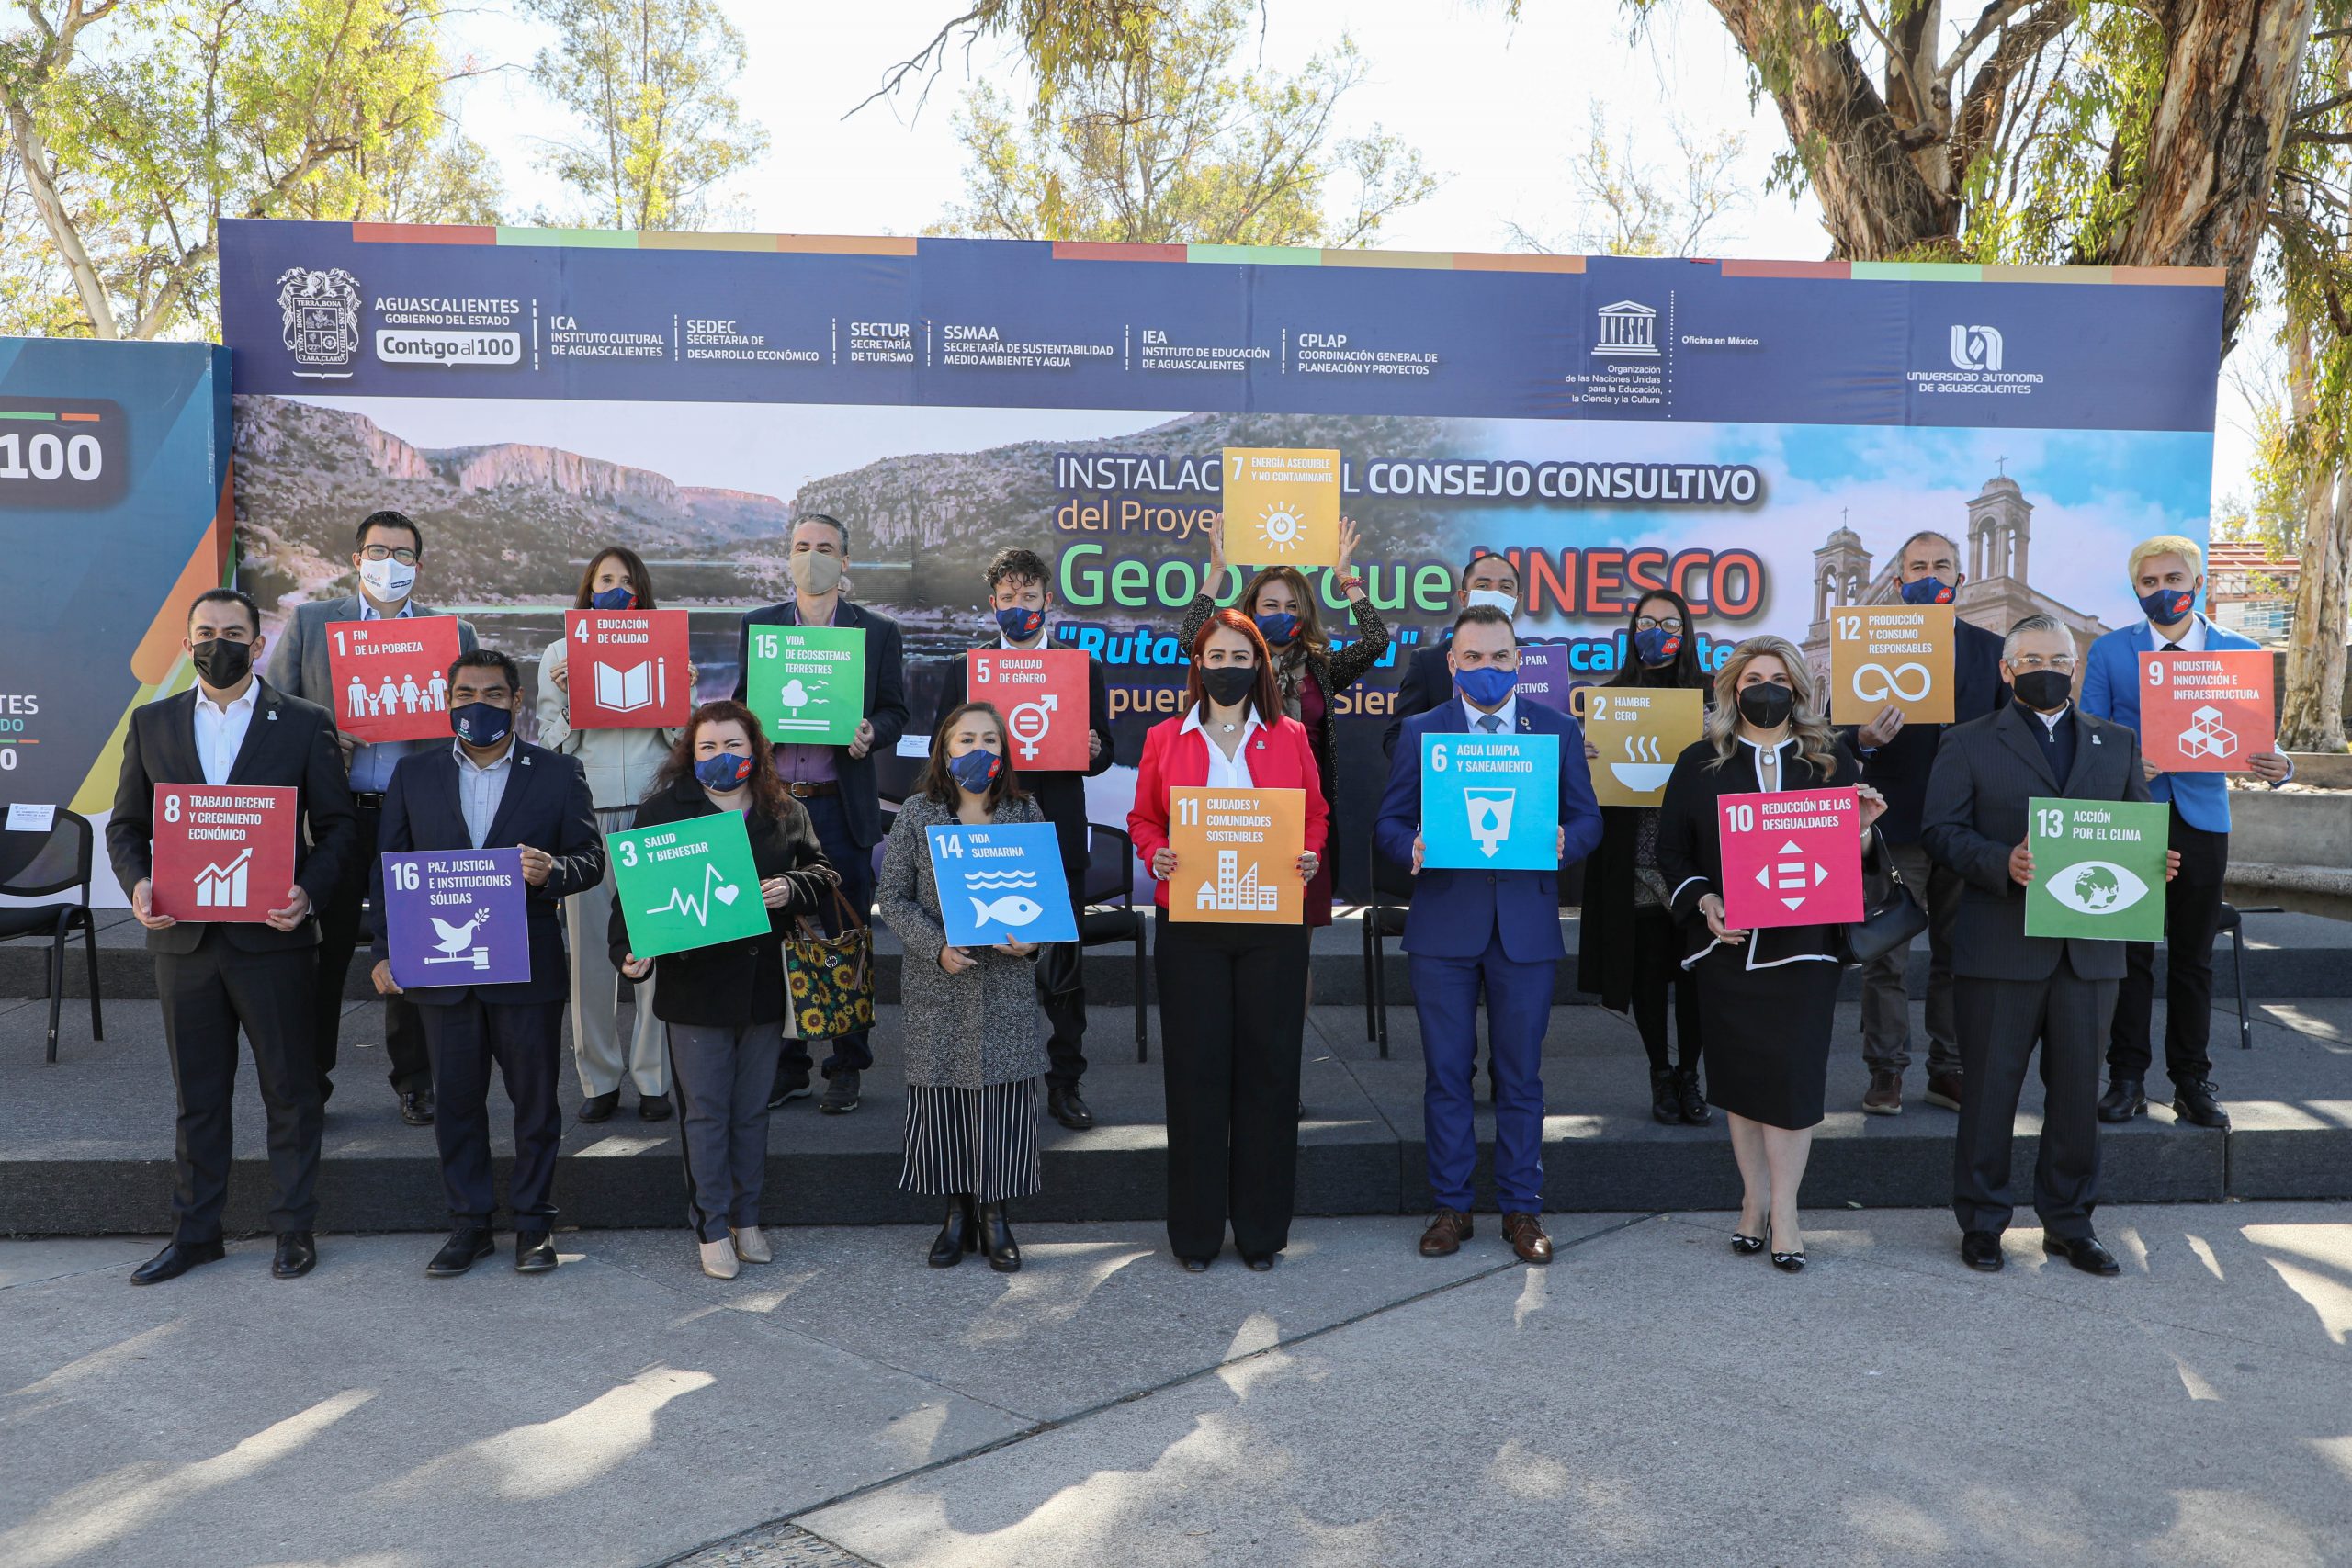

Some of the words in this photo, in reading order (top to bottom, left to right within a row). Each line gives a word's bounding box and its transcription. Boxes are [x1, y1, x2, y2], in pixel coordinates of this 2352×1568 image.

[375, 297, 519, 313] AGUASCALIENTES
[385, 314, 443, 324] GOBIERNO
[446, 315, 466, 325] DEL
[469, 315, 510, 326] ESTADO
[551, 316, 577, 330] ICA
[687, 320, 736, 334] SEDEC
[851, 322, 910, 337] SECTUR
[944, 325, 999, 340] SSMAA
[1600, 317, 1653, 344] UNESCO
[551, 333, 607, 344] INSTITUTO
[610, 333, 664, 344] CULTURAL
[687, 334, 749, 345] SECRETARIA
[751, 336, 764, 345] DE
[1143, 330, 1167, 344] IEA
[1299, 333, 1347, 348] CPLAP
[1681, 335, 1713, 344] Oficina
[1728, 336, 1758, 345] México
[383, 336, 457, 359] Contigo
[460, 338, 474, 355] al
[477, 338, 513, 355] 100
[551, 344, 566, 355] DE
[568, 345, 662, 356] AGUASCALIENTES
[851, 338, 911, 350] SECRETARÍA
[944, 342, 1005, 353] SECRETARÍA
[1007, 344, 1020, 353] DE
[1023, 344, 1114, 355] SUSTENTABILIDAD
[687, 349, 755, 360] DESARROLLO
[757, 349, 819, 361] ECONÓMICO
[851, 352, 865, 361] DE
[866, 352, 914, 362] TURISMO
[1142, 346, 1194, 357] INSTITUTO
[1196, 348, 1209, 357] DE
[1212, 347, 1270, 358] EDUCACIÓN
[1298, 350, 1374, 361] COORDINACIÓN
[1376, 352, 1422, 362] GENERAL
[1425, 353, 1438, 363] DE
[944, 355, 978, 365] MEDIO
[979, 355, 1033, 366] AMBIENTE
[1035, 356, 1042, 366] Y
[1043, 357, 1071, 367] AGUA
[1142, 359, 1156, 368] DE
[1157, 359, 1245, 370] AGUASCALIENTES
[1298, 362, 1362, 373] PLANEACIÓN
[1363, 364, 1371, 373] Y
[1373, 364, 1429, 375] PROYECTOS
[1607, 365, 1661, 375] Organización
[1577, 374, 1590, 382] las
[1592, 375, 1630, 383] Naciones
[1633, 376, 1661, 384] Unidas
[1588, 386, 1606, 394] para
[1609, 385, 1616, 393] la
[1618, 385, 1663, 395] Educación,
[1919, 383, 1934, 392] DE
[1572, 394, 1579, 402] la
[1581, 394, 1612, 403] Ciencia
[1614, 397, 1620, 405] y
[1622, 395, 1629, 403] la
[1631, 395, 1660, 404] Cultura
[1232, 457, 1244, 480] 7
[1251, 456, 1285, 468] ENERGÍA
[1286, 458, 1330, 469] ASEQUIBLE
[1058, 458, 1220, 491] INSTALAC
[1369, 463, 1531, 496] CONSEJO
[1538, 467, 1757, 501] CONSULTIVO
[1251, 471, 1258, 481] Y
[1259, 471, 1271, 481] NO
[1272, 471, 1333, 483] CONTAMINANTE
[1058, 500, 1108, 530] del
[1122, 501, 1217, 539] Proye
[1475, 551, 1760, 615] NESCO
[597, 616, 649, 629] EDUCACIÓN
[1868, 613, 1924, 626] PRODUCCIÓN
[574, 619, 590, 643] 4
[1837, 615, 1861, 640] 12
[353, 630, 368, 640] FIN
[597, 634, 608, 643] DE
[611, 634, 649, 643] CALIDAD
[786, 635, 805, 646] VIDA
[1869, 629, 1874, 639] Y
[1876, 629, 1918, 640] CONSUMO
[334, 631, 345, 656] 1
[355, 645, 367, 655] DE
[368, 644, 380, 654] LA
[382, 641, 424, 654] POBREZA
[755, 634, 778, 659] 15
[1869, 643, 1932, 654] RESPONSABLES
[786, 649, 796, 660] DE
[797, 649, 851, 661] ECOSISTEMAS
[1525, 655, 1548, 665] PARA
[785, 663, 832, 674] TERRESTRES
[1000, 659, 1042, 669] IGUALDAD
[2173, 660, 2224, 672] INDUSTRIA,
[978, 659, 990, 683] 5
[1000, 673, 1010, 683] DE
[1012, 671, 1046, 683] GÉNERO
[2149, 661, 2164, 686] 9
[2173, 672, 2230, 685] INNOVACIÓN
[2232, 675, 2237, 685] E
[2174, 689, 2259, 700] INFRAESTRUCTURA
[1109, 688, 1190, 720] puer
[1593, 695, 1607, 720] 2
[1614, 696, 1651, 707] HAMBRE
[1614, 711, 1637, 721] CERO
[1456, 744, 1484, 756] AGUA
[1487, 744, 1520, 756] LIMPIA
[1431, 744, 1447, 772] 6
[1456, 761, 1464, 772] Y
[1465, 761, 1532, 773] SANEAMIENTO
[164, 795, 180, 822] 8
[189, 795, 232, 807] TRABAJO
[234, 797, 276, 809] DECENTE
[1206, 798, 1251, 810] CIUDADES
[1253, 799, 1259, 810] Y
[1762, 797, 1816, 815] REDUCCIÓN
[1819, 799, 1831, 811] DE
[1834, 798, 1851, 810] LAS
[1177, 797, 1198, 825] 11
[2073, 808, 2111, 823] ACCIÓN
[189, 812, 196, 823] Y
[198, 812, 262, 825] CRECIMIENTO
[1206, 815, 1272, 827] COMUNIDADES
[1725, 805, 1754, 832] 10
[1763, 816, 1839, 830] DESIGUALDADES
[2037, 809, 2064, 838] 13
[188, 826, 246, 840] ECONÓMICO
[968, 833, 990, 843] VIDA
[1206, 830, 1264, 842] SOSTENIBLES
[2073, 827, 2093, 839] POR
[2097, 828, 2107, 840] EL
[2110, 829, 2141, 841] CLIMA
[644, 833, 677, 848] SALUD
[935, 834, 964, 858] 14
[619, 840, 638, 867] 3
[647, 852, 653, 863] Y
[656, 842, 709, 862] BIENESTAR
[971, 847, 1024, 858] SUBMARINA
[428, 862, 449, 874] PAZ,
[452, 859, 495, 872] JUSTICIA
[391, 863, 420, 890] 16
[429, 878, 435, 889] E
[437, 874, 512, 888] INSTITUCIONES
[430, 890, 472, 905] SÓLIDAS
